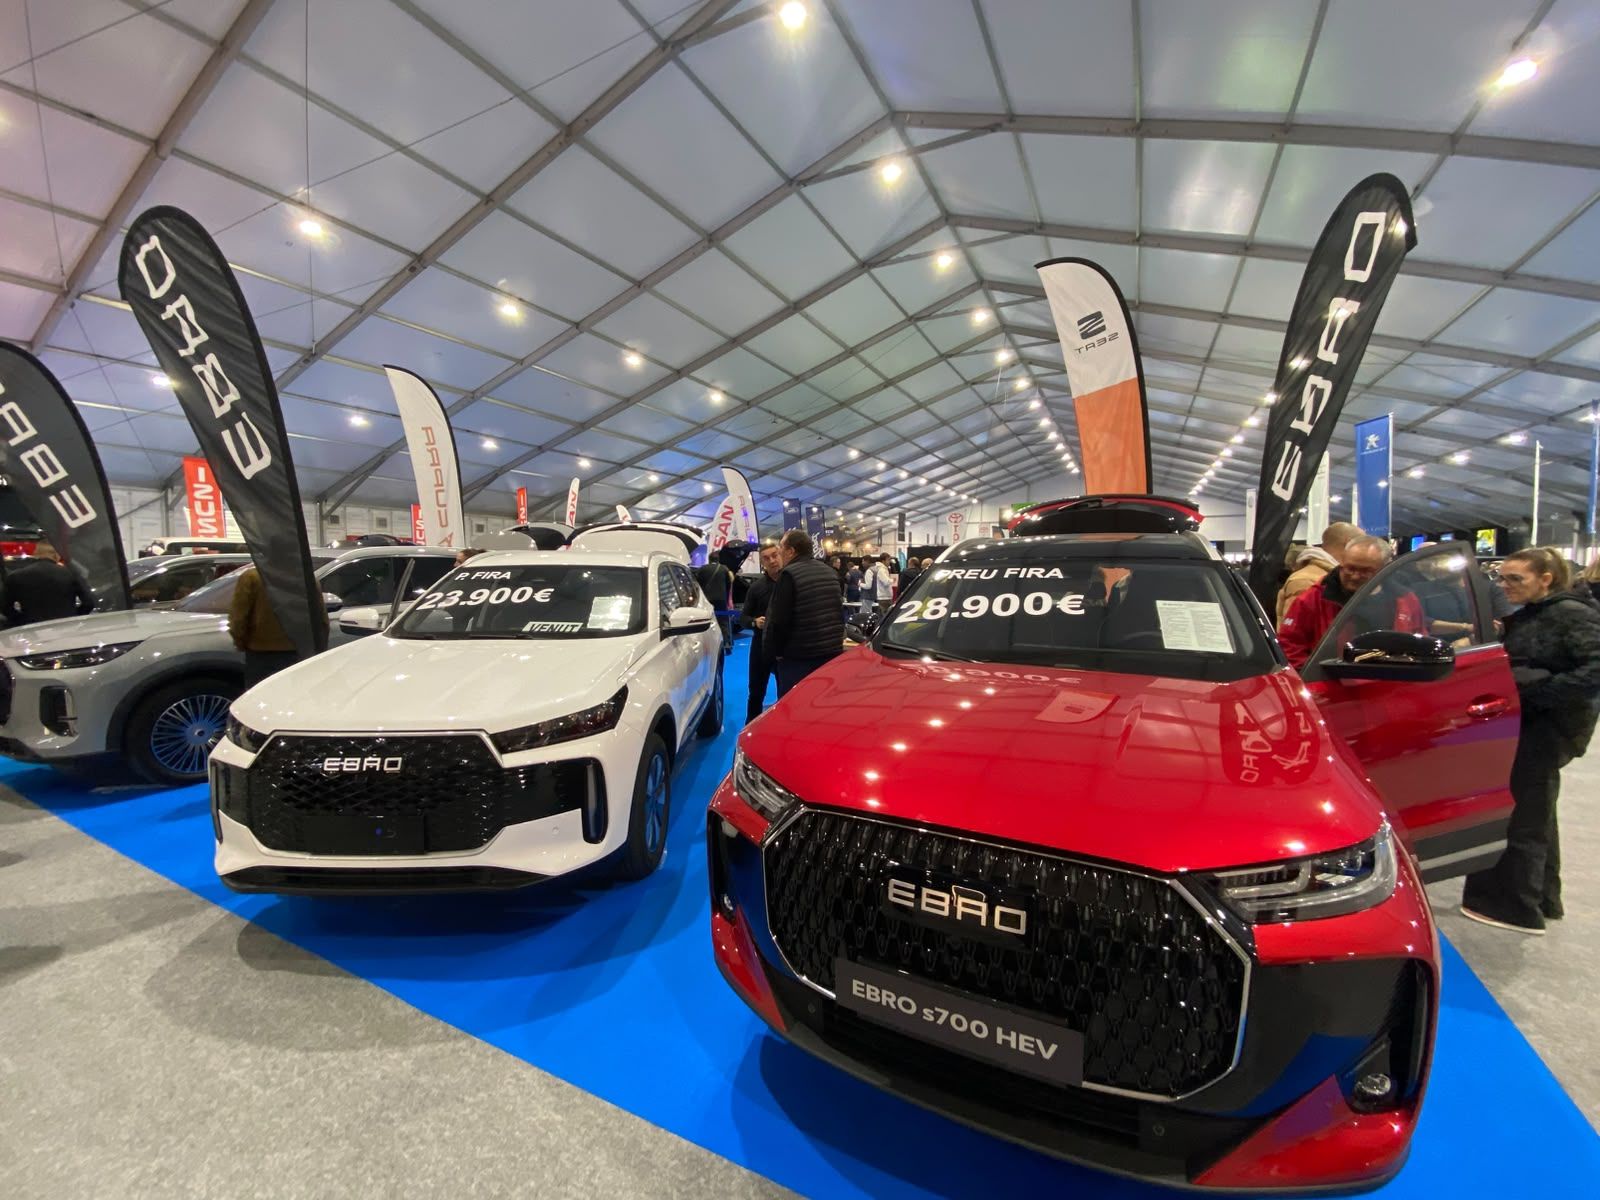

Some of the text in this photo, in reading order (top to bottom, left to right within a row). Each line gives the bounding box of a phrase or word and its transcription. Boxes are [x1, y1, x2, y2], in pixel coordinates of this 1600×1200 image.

[1270, 211, 1388, 501] EBRO
[472, 570, 512, 581] FIRA
[936, 567, 1064, 580] PREU FIRA
[415, 586, 555, 611] 23.900€
[893, 591, 1086, 624] 28.900€
[323, 757, 402, 772] EBRO
[887, 878, 1027, 936] EBRO
[852, 979, 1059, 1061] EBRO s700 HEV
